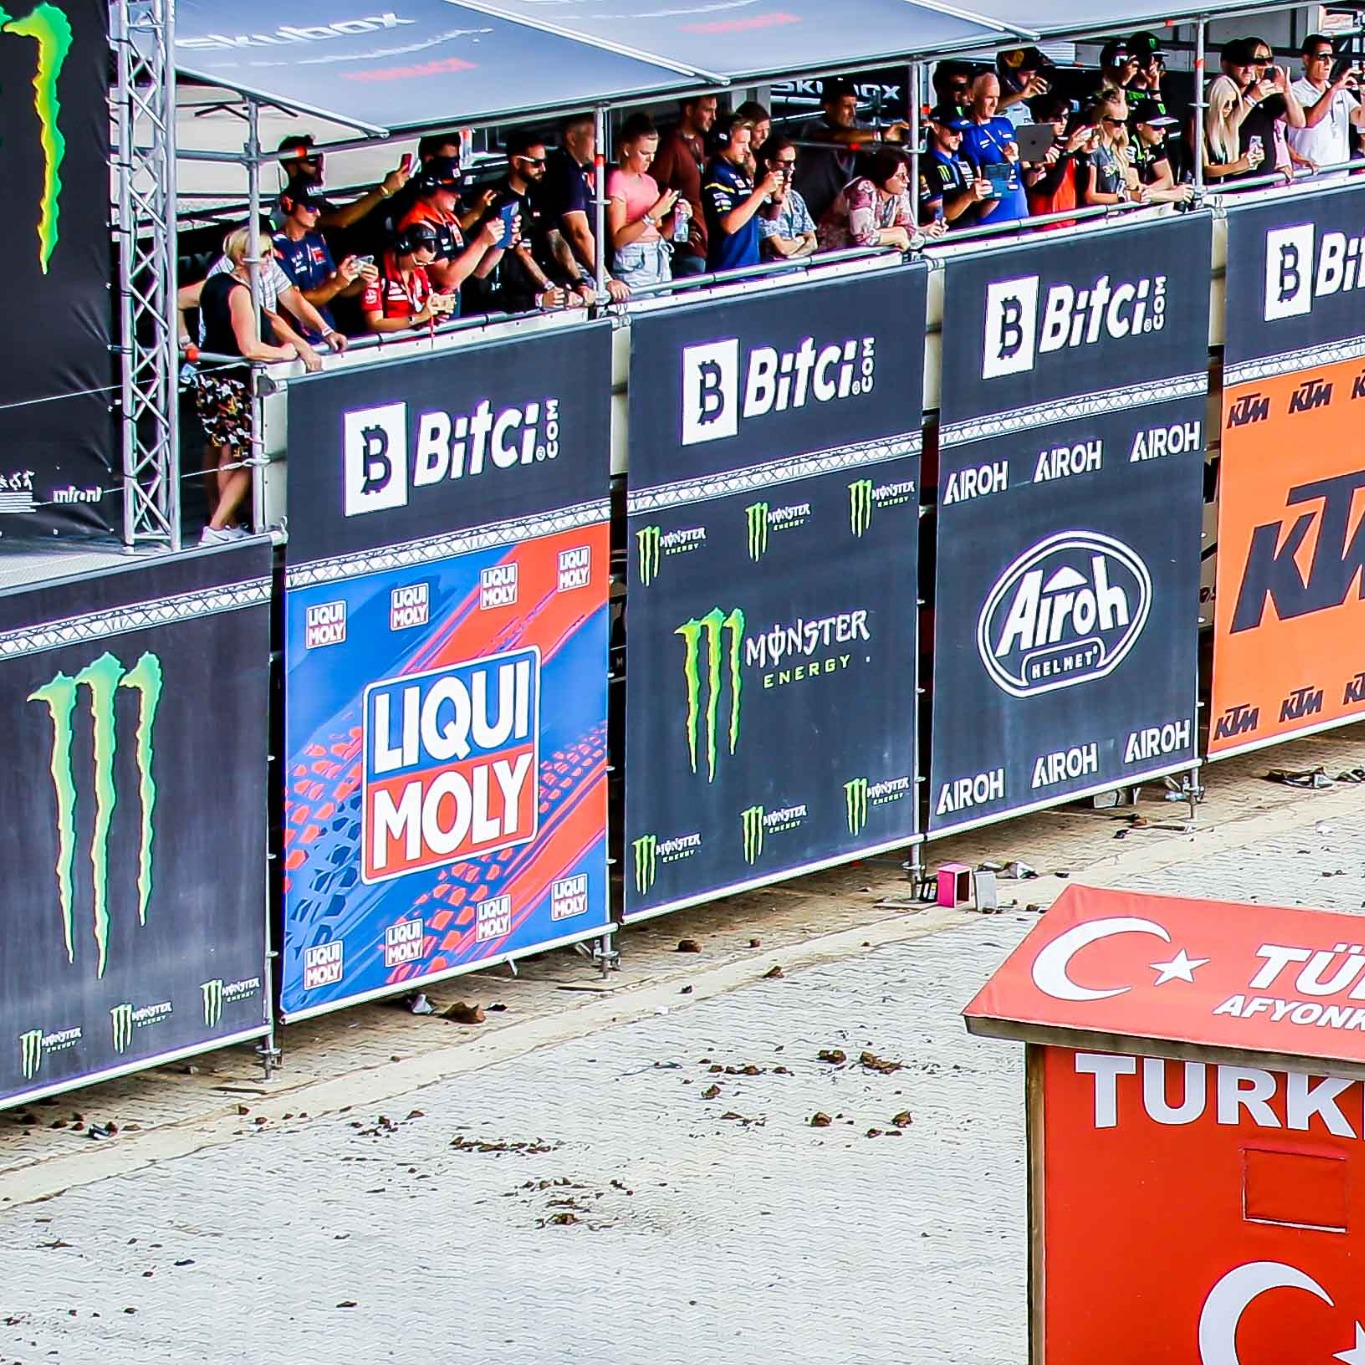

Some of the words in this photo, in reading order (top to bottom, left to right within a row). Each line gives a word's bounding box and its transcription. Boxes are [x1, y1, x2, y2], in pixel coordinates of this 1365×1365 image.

[1039, 276, 1149, 352] Bitci
[743, 337, 857, 418] Bitci
[1226, 392, 1270, 429] KTM
[1288, 378, 1333, 414] KTM
[413, 400, 539, 487] Bitci
[1129, 421, 1201, 463] AIROH
[1033, 440, 1103, 484] AIROH
[943, 460, 1008, 505] AIROH
[482, 565, 515, 590] LIQUI
[559, 549, 588, 573] LIQUI
[393, 584, 426, 609] LIQUI
[481, 585, 516, 609] MOLY
[558, 569, 590, 592] MOLY
[308, 603, 343, 627] LIQUI
[393, 606, 428, 629] MOLY
[996, 555, 1130, 657] Airoh
[308, 624, 345, 648] MOLY
[746, 609, 870, 668] MONSTER
[763, 654, 851, 688] ENERGY
[1032, 650, 1094, 679] HELMET
[374, 660, 531, 774] LIQUI
[1278, 686, 1324, 722] KTM
[1213, 704, 1260, 741] KTM
[1124, 719, 1191, 764] AIROH
[1031, 742, 1098, 788] AIROH
[936, 768, 1005, 816] AIROH
[373, 753, 533, 870] MOLY
[553, 876, 586, 900] LIQUI
[478, 897, 509, 921] LIQUI
[553, 896, 587, 919] MOLY
[388, 922, 422, 946] LIQUI
[477, 917, 510, 940] MOLY
[307, 943, 340, 967] LIQUI
[387, 942, 422, 965] MOLY
[306, 963, 341, 987] MOLY
